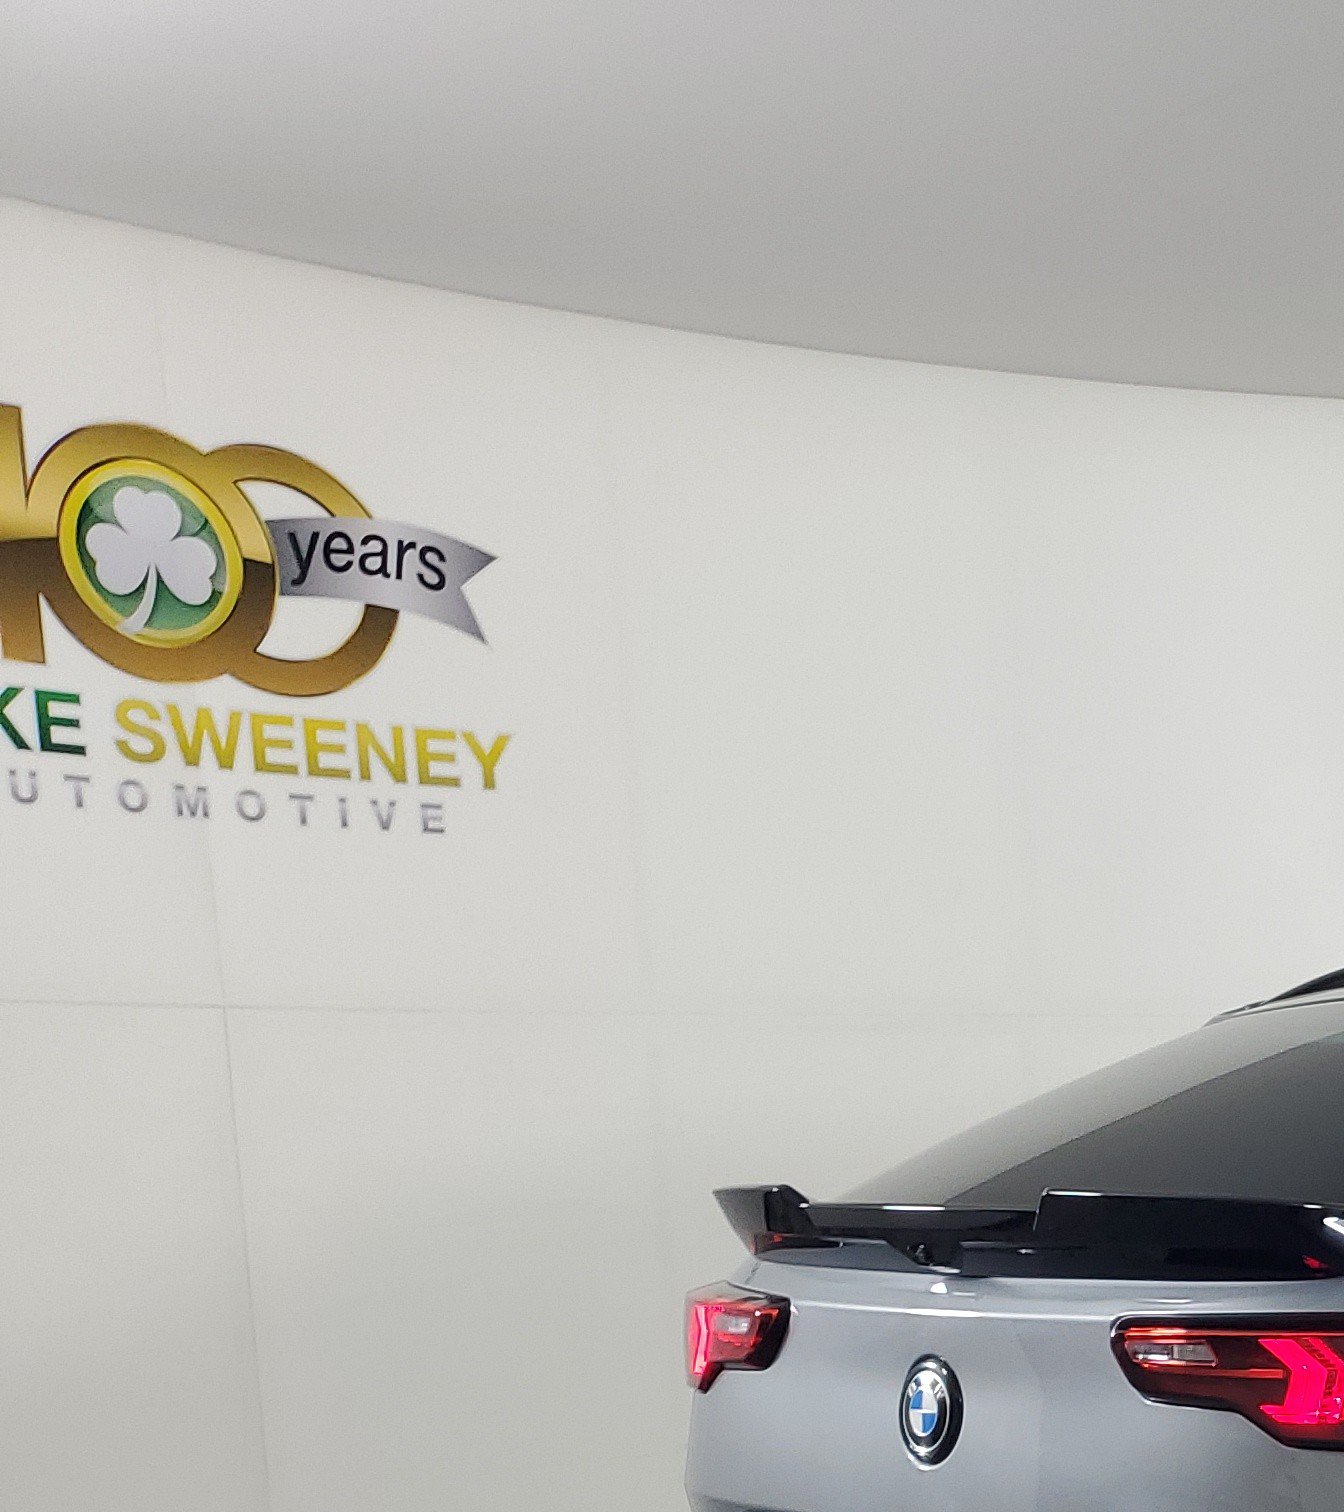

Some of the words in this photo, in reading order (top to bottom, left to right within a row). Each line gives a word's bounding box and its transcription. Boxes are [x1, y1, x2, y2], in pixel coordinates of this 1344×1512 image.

[287, 528, 447, 592] years
[114, 697, 512, 792] SWEENEY
[8, 768, 448, 835] UTOMOTIVE
